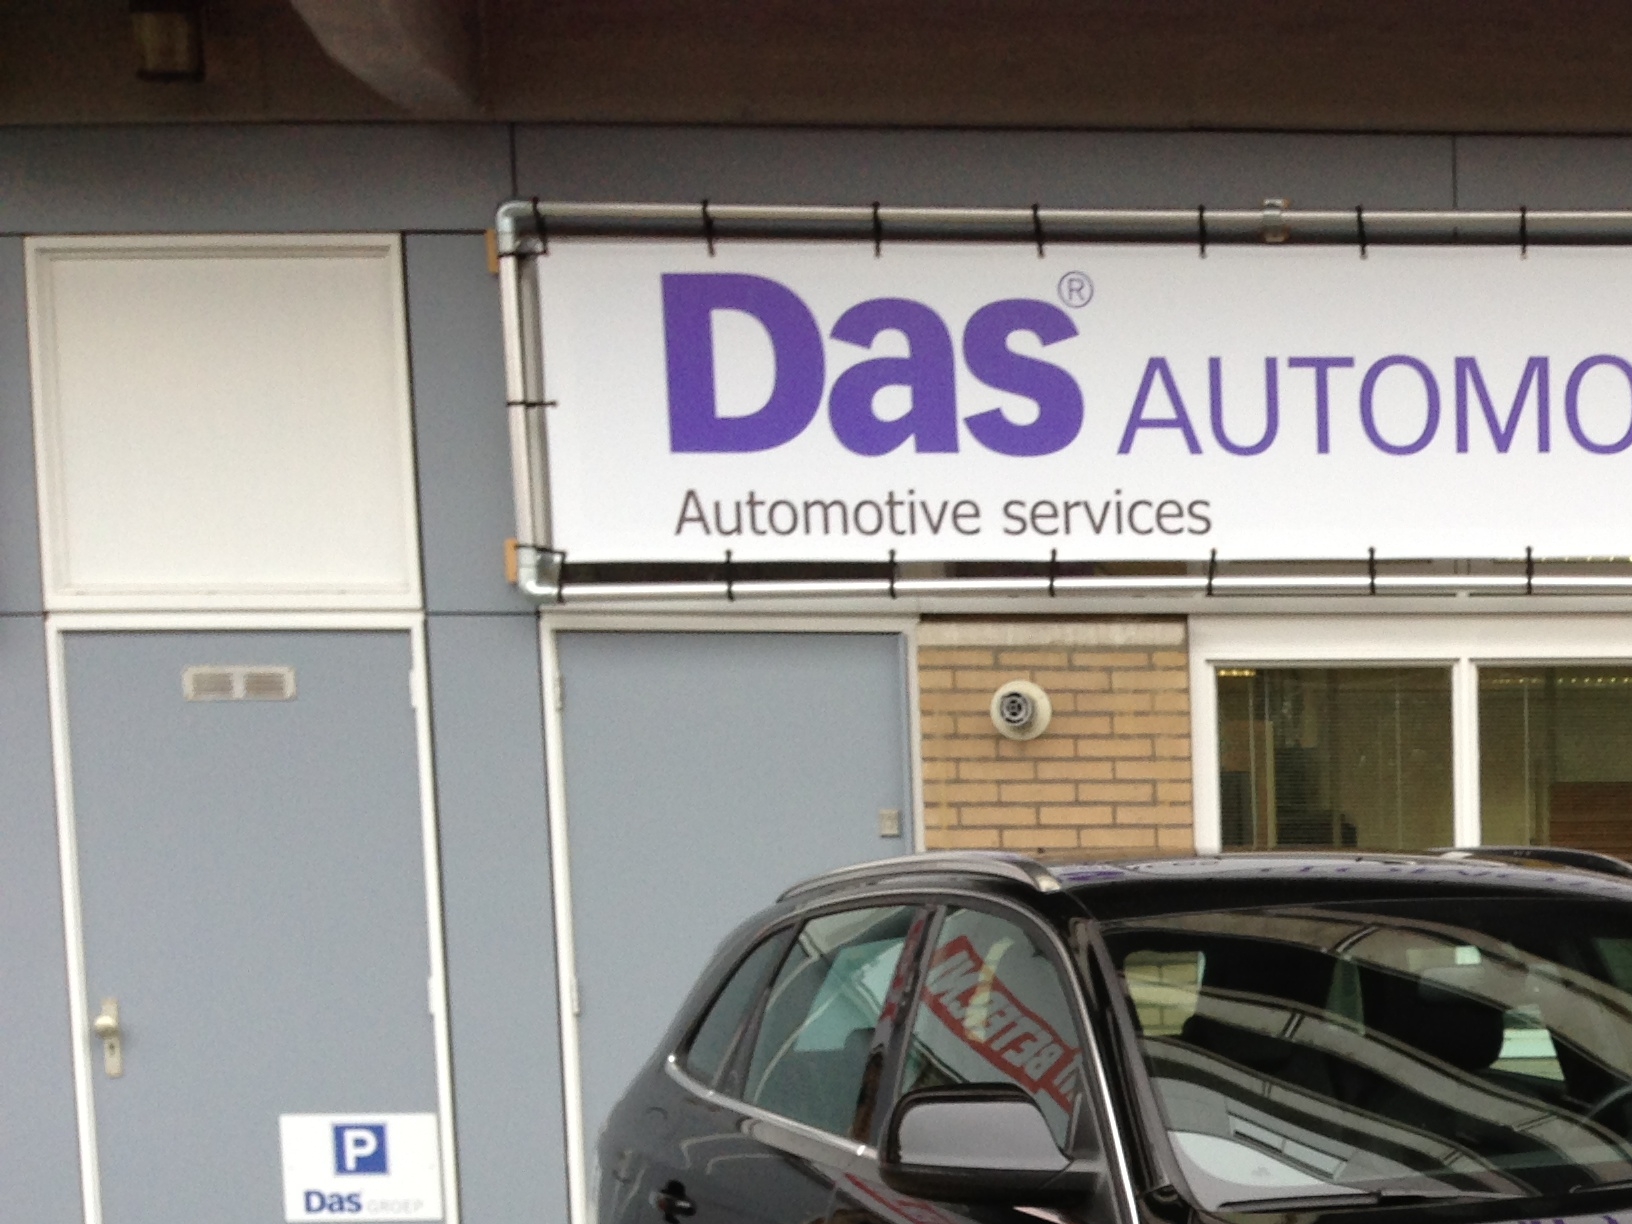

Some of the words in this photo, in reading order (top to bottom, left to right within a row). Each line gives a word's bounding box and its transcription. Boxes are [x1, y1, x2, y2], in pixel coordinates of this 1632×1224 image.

[675, 489, 981, 536] Automotive
[1002, 489, 1212, 535] services
[304, 1190, 362, 1213] Das
